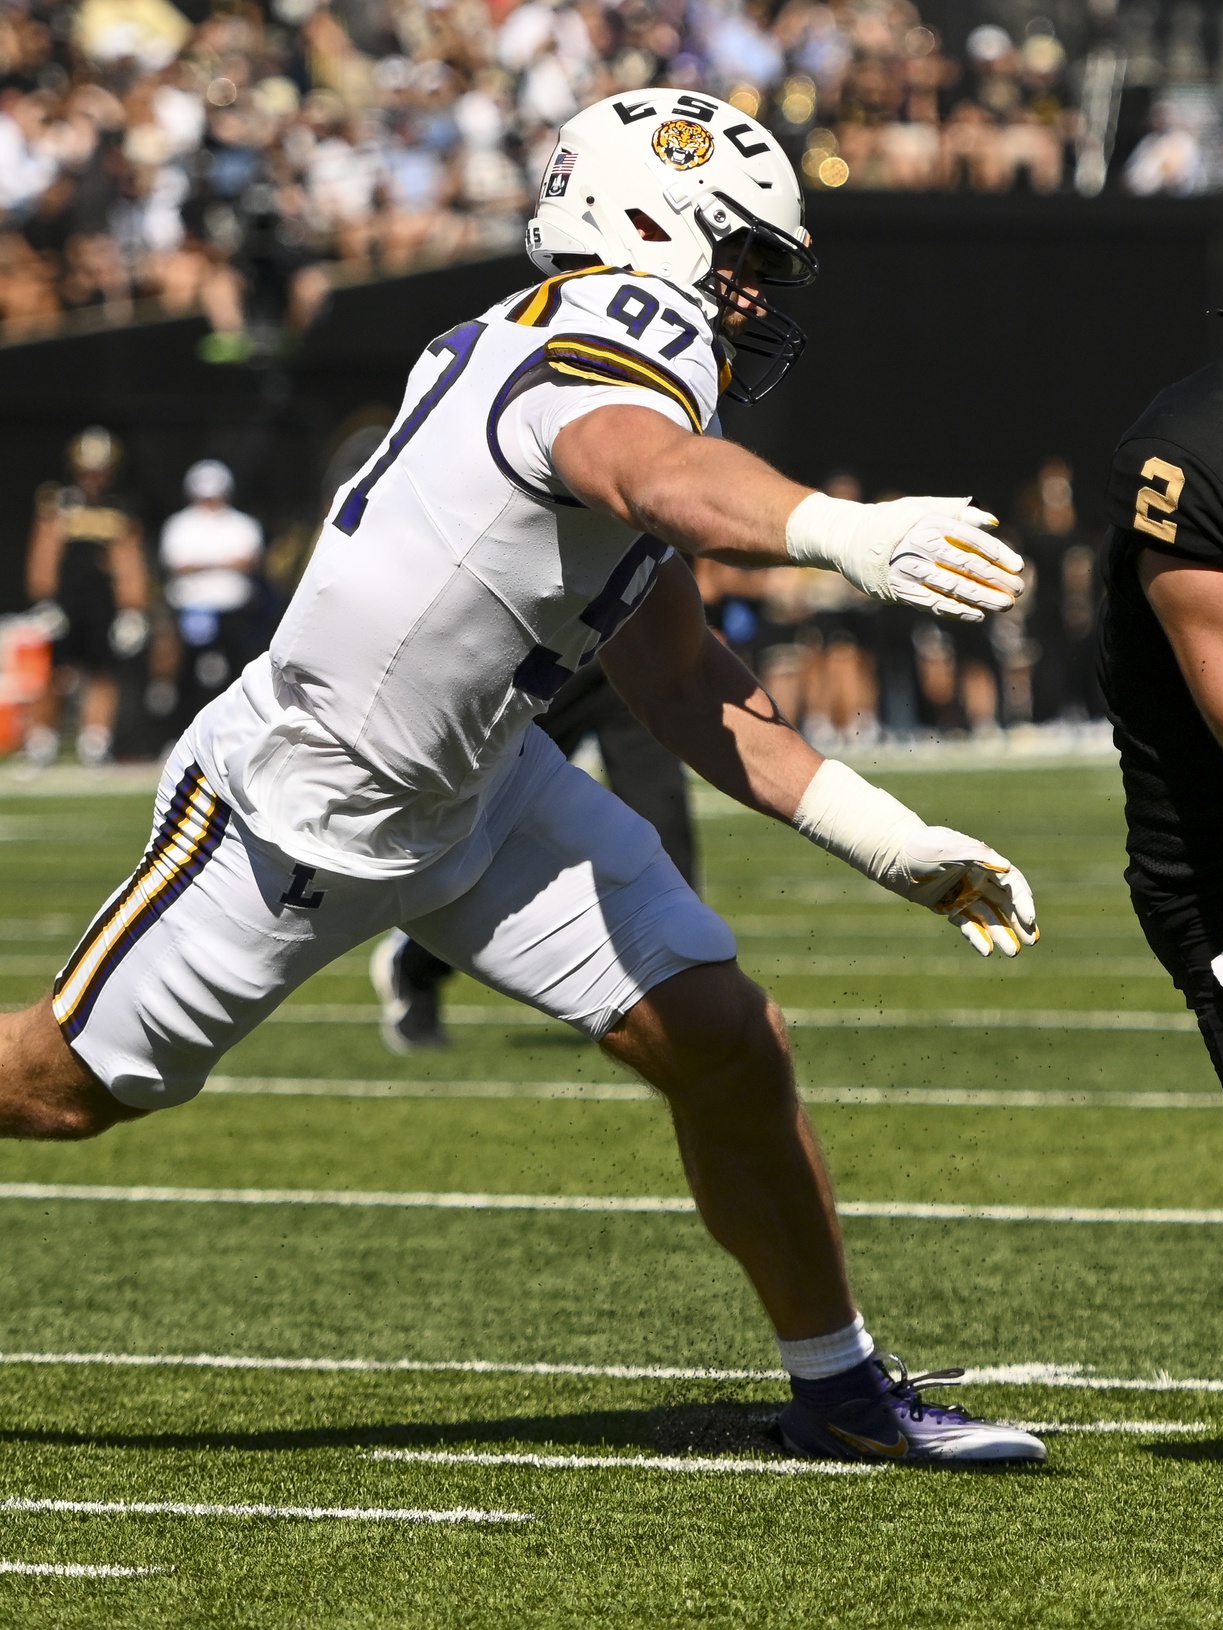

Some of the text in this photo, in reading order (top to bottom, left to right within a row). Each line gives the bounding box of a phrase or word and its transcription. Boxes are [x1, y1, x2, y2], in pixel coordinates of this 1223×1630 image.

[612, 95, 771, 158] LSU
[606, 284, 699, 360] 97
[1133, 456, 1186, 545] 2
[279, 860, 328, 909] L
